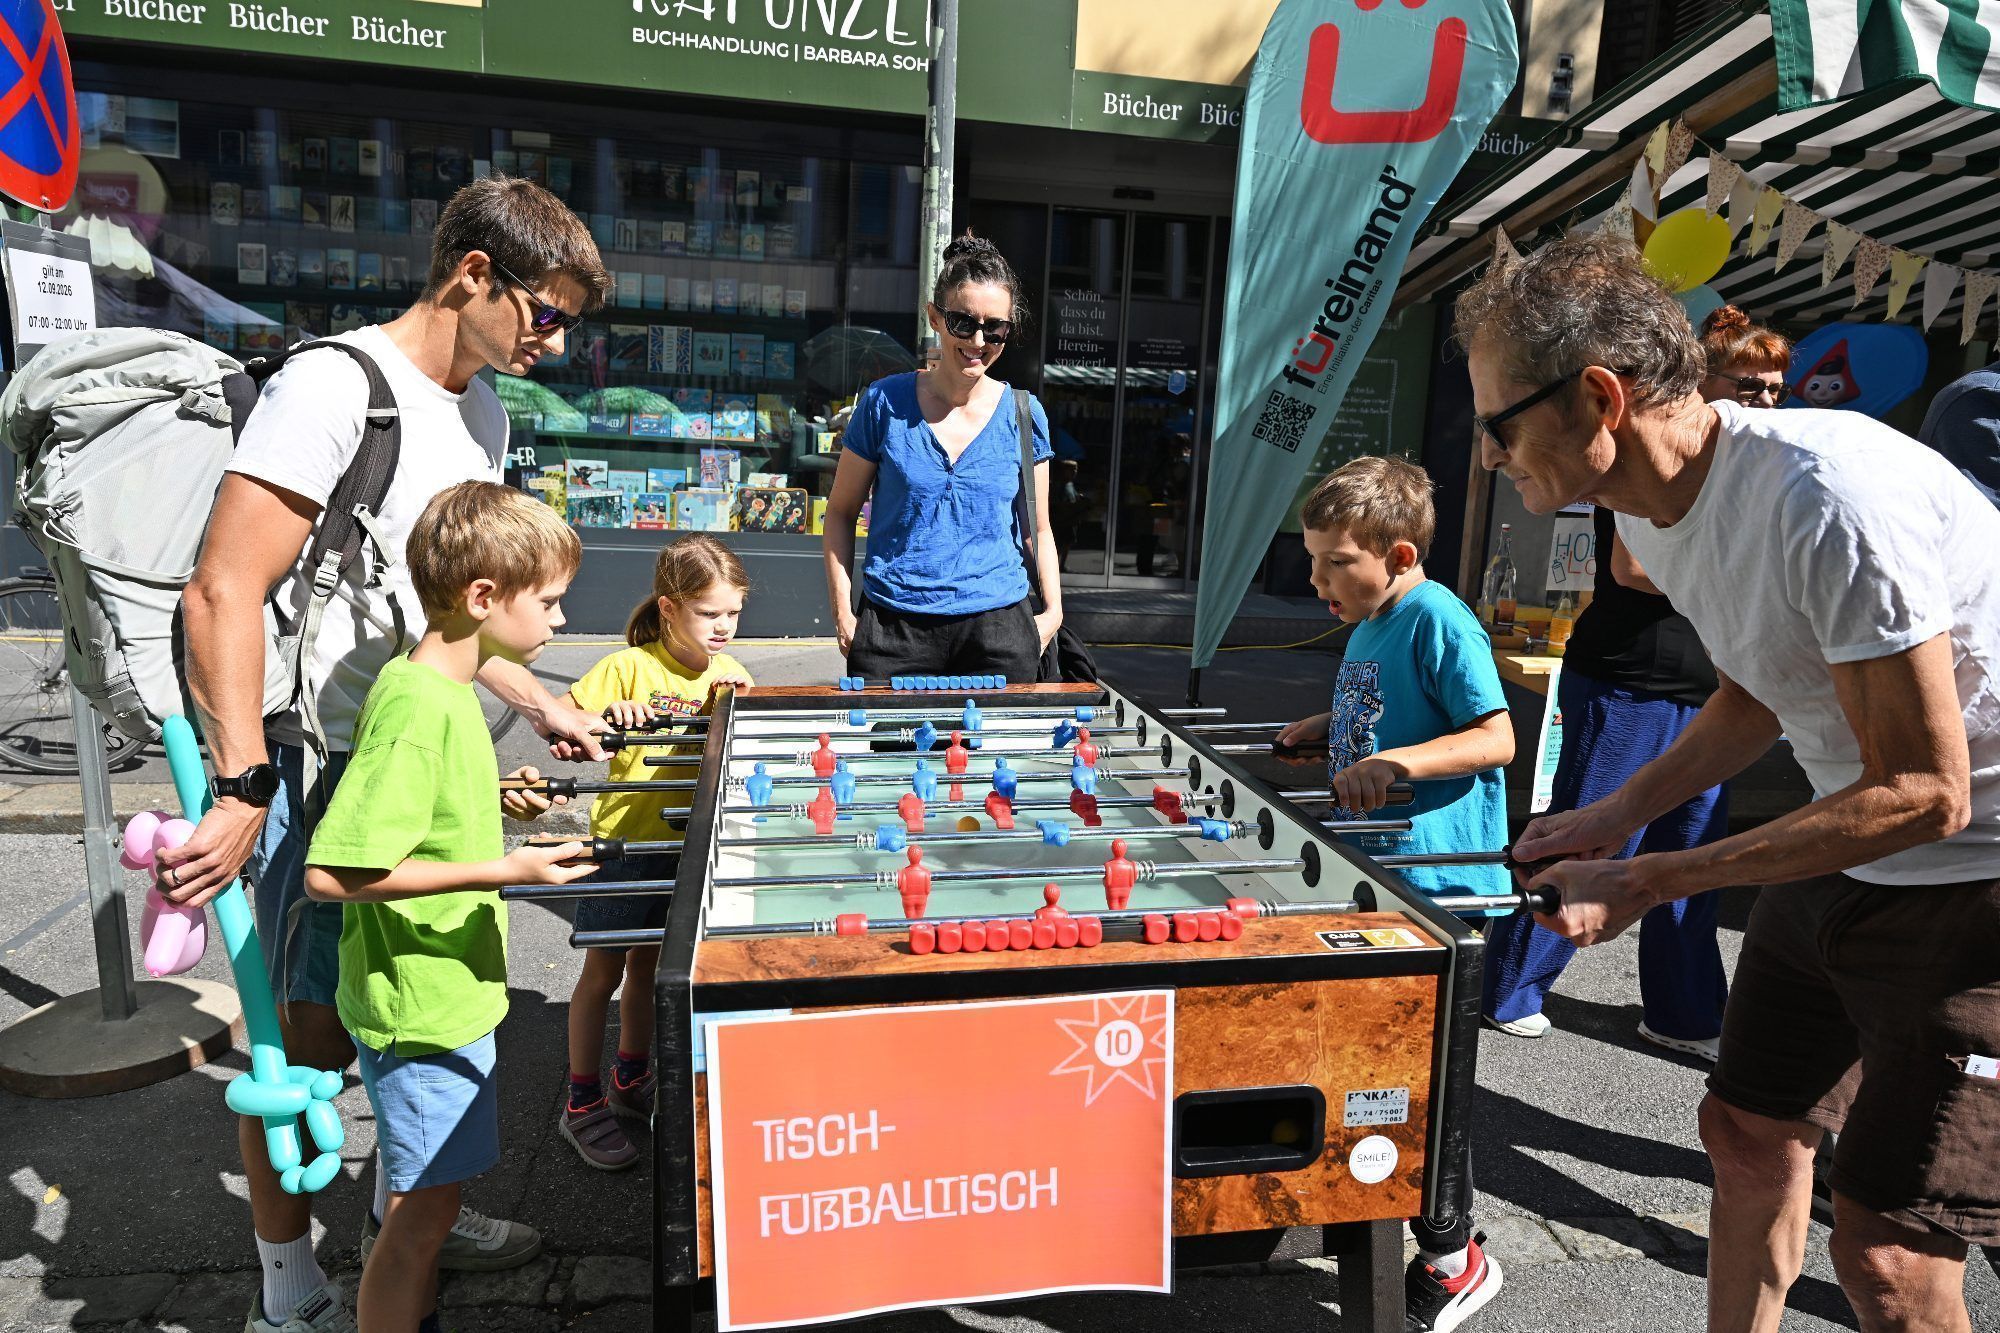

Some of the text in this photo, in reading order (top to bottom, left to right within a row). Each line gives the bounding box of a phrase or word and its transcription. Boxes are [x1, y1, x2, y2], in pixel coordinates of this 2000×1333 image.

[229, 3, 329, 37] Bücher
[351, 15, 447, 48] Bücher
[632, 27, 789, 58] BUCHHANDLUNG
[804, 45, 888, 68] BARBARA
[892, 55, 929, 72] SOH
[1102, 92, 1240, 127] Bücher Büc
[42, 265, 64, 279] gilt am
[1064, 288, 1105, 303] Schön,
[1060, 305, 1106, 320] dass du
[28, 315, 49, 329] 07:00
[54, 317, 73, 330] 22:00
[74, 318, 88, 331] Uhr
[1060, 322, 1075, 334] da
[1318, 278, 1384, 395] Eine Initiative der Caritas
[1058, 338, 1105, 352] Herein-
[1055, 356, 1106, 371] spaziert!
[1105, 1029, 1132, 1056] 10
